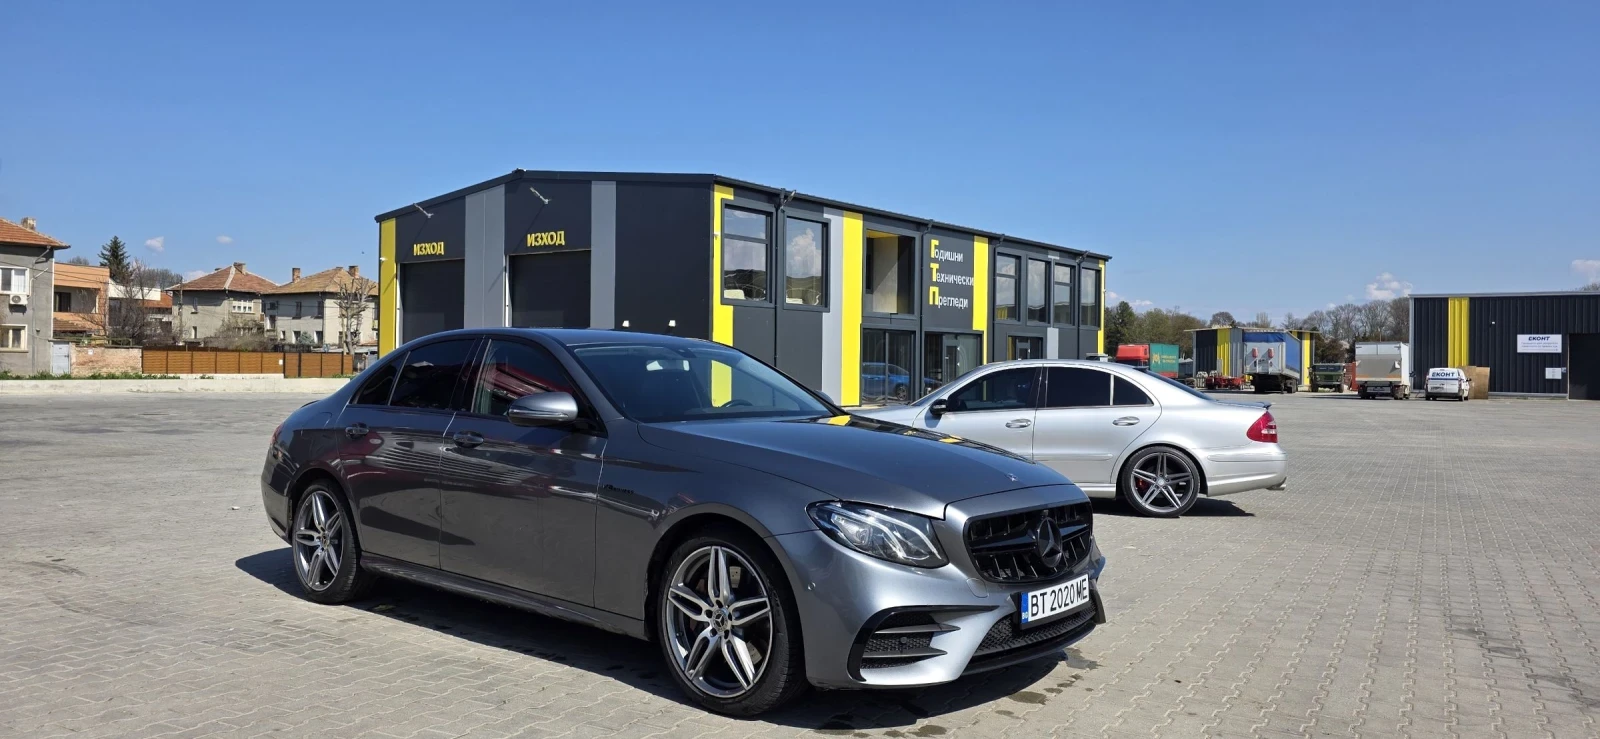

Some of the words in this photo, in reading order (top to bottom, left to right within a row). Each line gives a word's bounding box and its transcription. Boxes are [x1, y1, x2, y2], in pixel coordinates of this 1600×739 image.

[413, 242, 444, 256] ИЗХОД
[527, 231, 565, 247] ИЗХОД
[930, 239, 963, 262] Годишни
[930, 263, 974, 286] Технически
[929, 286, 968, 309] Прегледи
[1031, 592, 1048, 617] BT
[1050, 584, 1075, 612] 2020
[1076, 578, 1088, 603] ME
